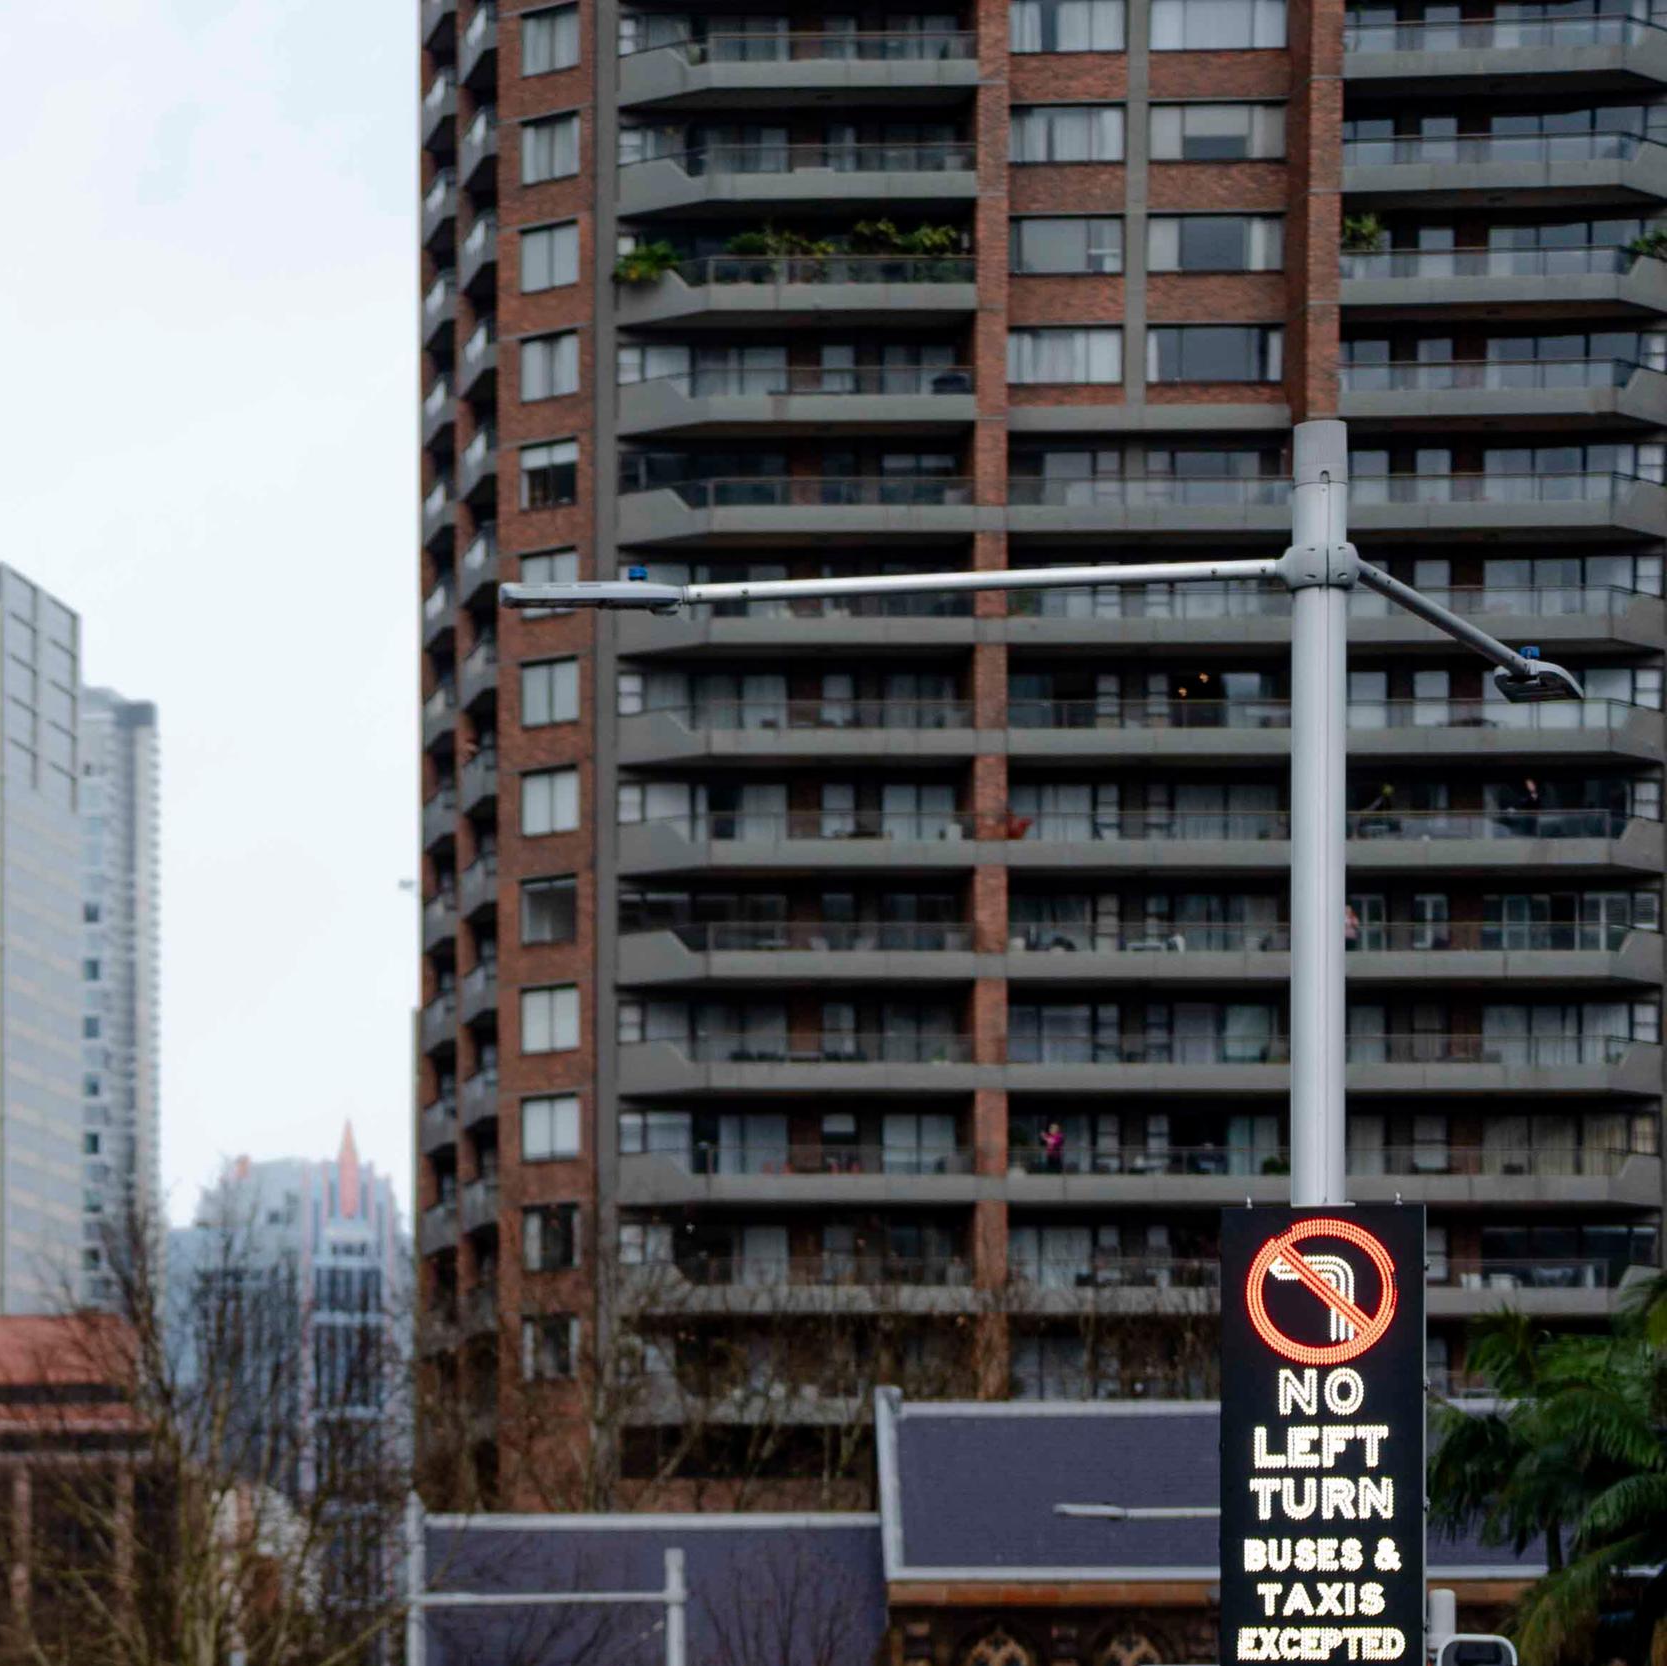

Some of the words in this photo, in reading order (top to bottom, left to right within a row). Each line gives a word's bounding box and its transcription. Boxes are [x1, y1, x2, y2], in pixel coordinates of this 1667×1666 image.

[1278, 1368, 1364, 1416] NO
[1253, 1425, 1389, 1468] LEFT
[1249, 1476, 1394, 1521] TURN
[1244, 1538, 1364, 1571] BUSES
[1374, 1538, 1402, 1572] &
[1257, 1583, 1385, 1616] TAXIS
[1237, 1627, 1406, 1661] EXCEPTED
